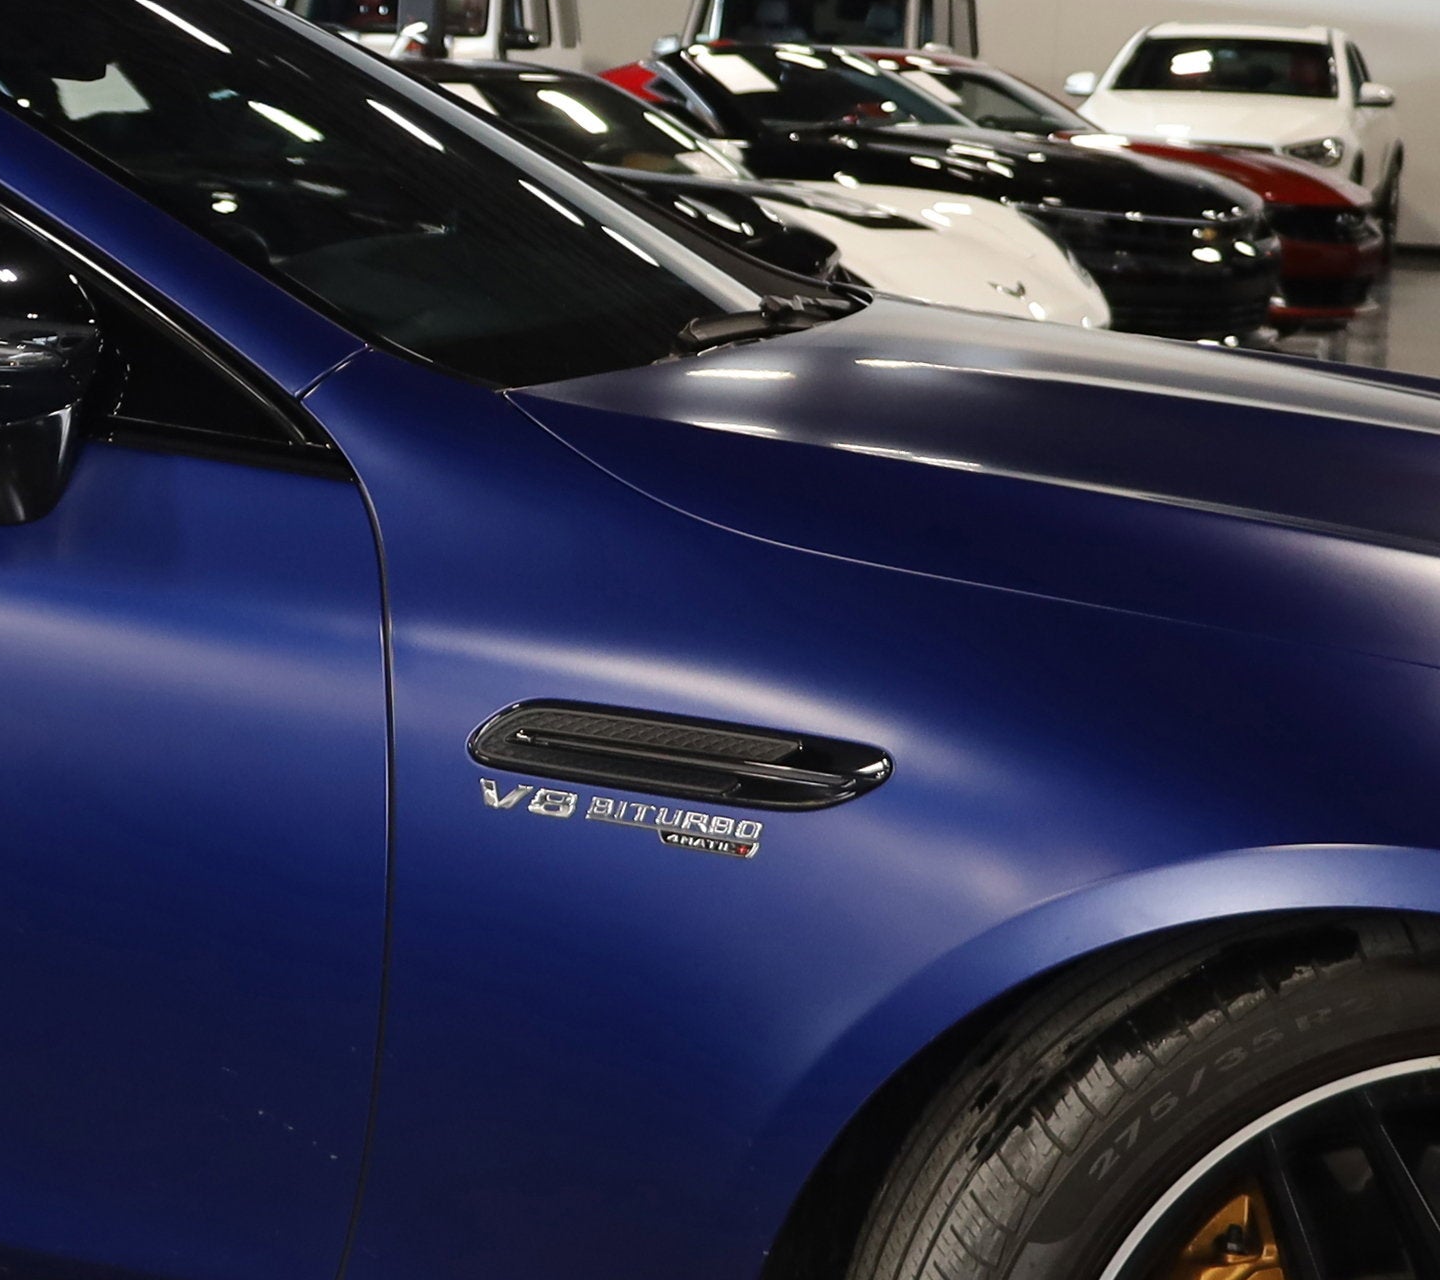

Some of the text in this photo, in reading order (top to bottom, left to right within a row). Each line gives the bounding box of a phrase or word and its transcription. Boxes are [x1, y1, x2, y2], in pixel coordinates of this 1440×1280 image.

[479, 777, 763, 840] V8 BITURBO
[1087, 1026, 1286, 1182] 275/35
